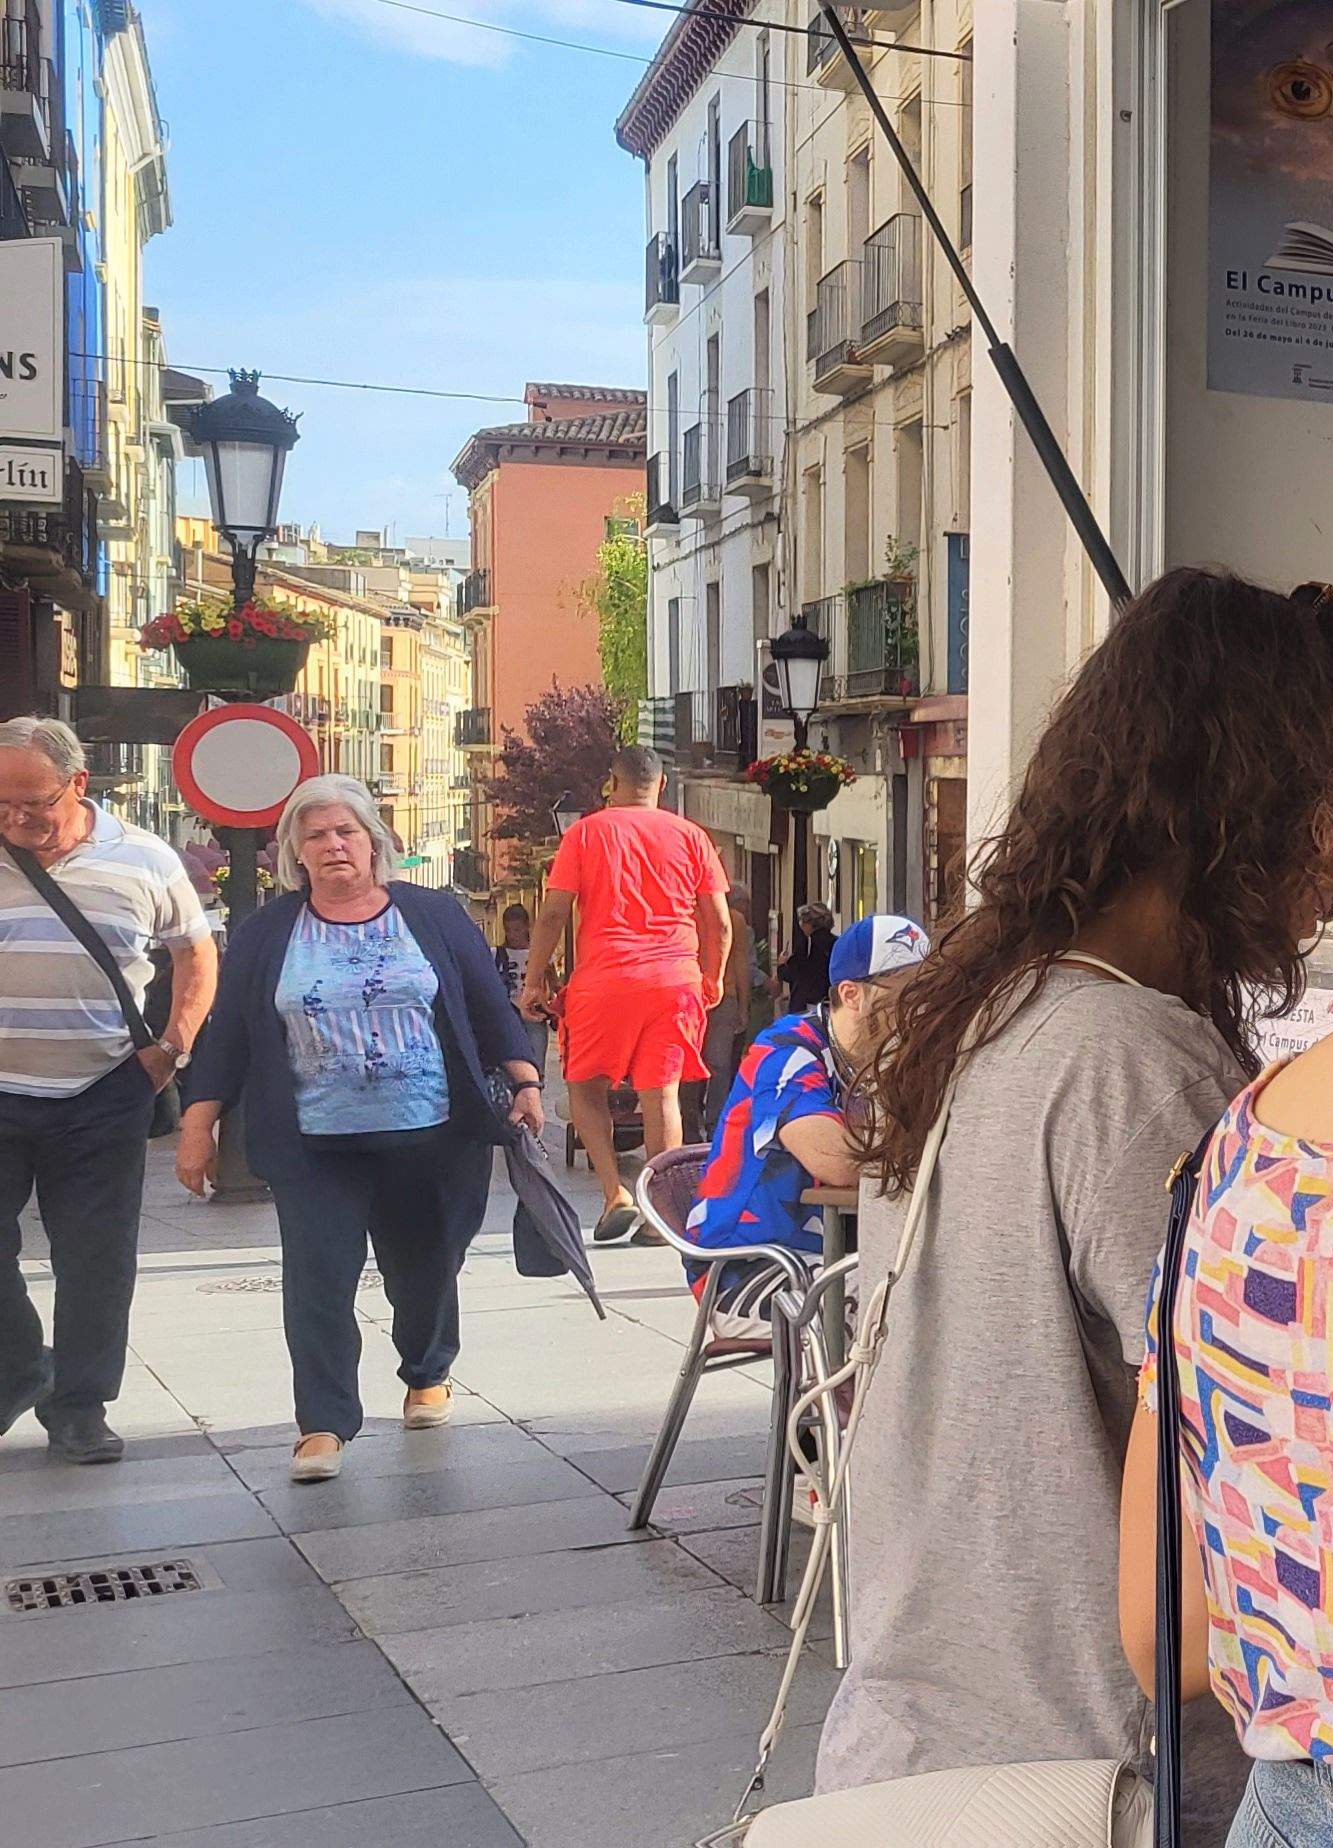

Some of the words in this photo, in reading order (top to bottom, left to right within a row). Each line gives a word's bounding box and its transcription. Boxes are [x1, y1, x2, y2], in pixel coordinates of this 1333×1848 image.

[1226, 270, 1247, 291] El
[1225, 328, 1240, 337] Del
[1243, 330, 1254, 338] 26
[1257, 332, 1267, 340] de
[1269, 334, 1293, 344] mayo
[1295, 336, 1303, 345] al
[1313, 338, 1323, 347] de
